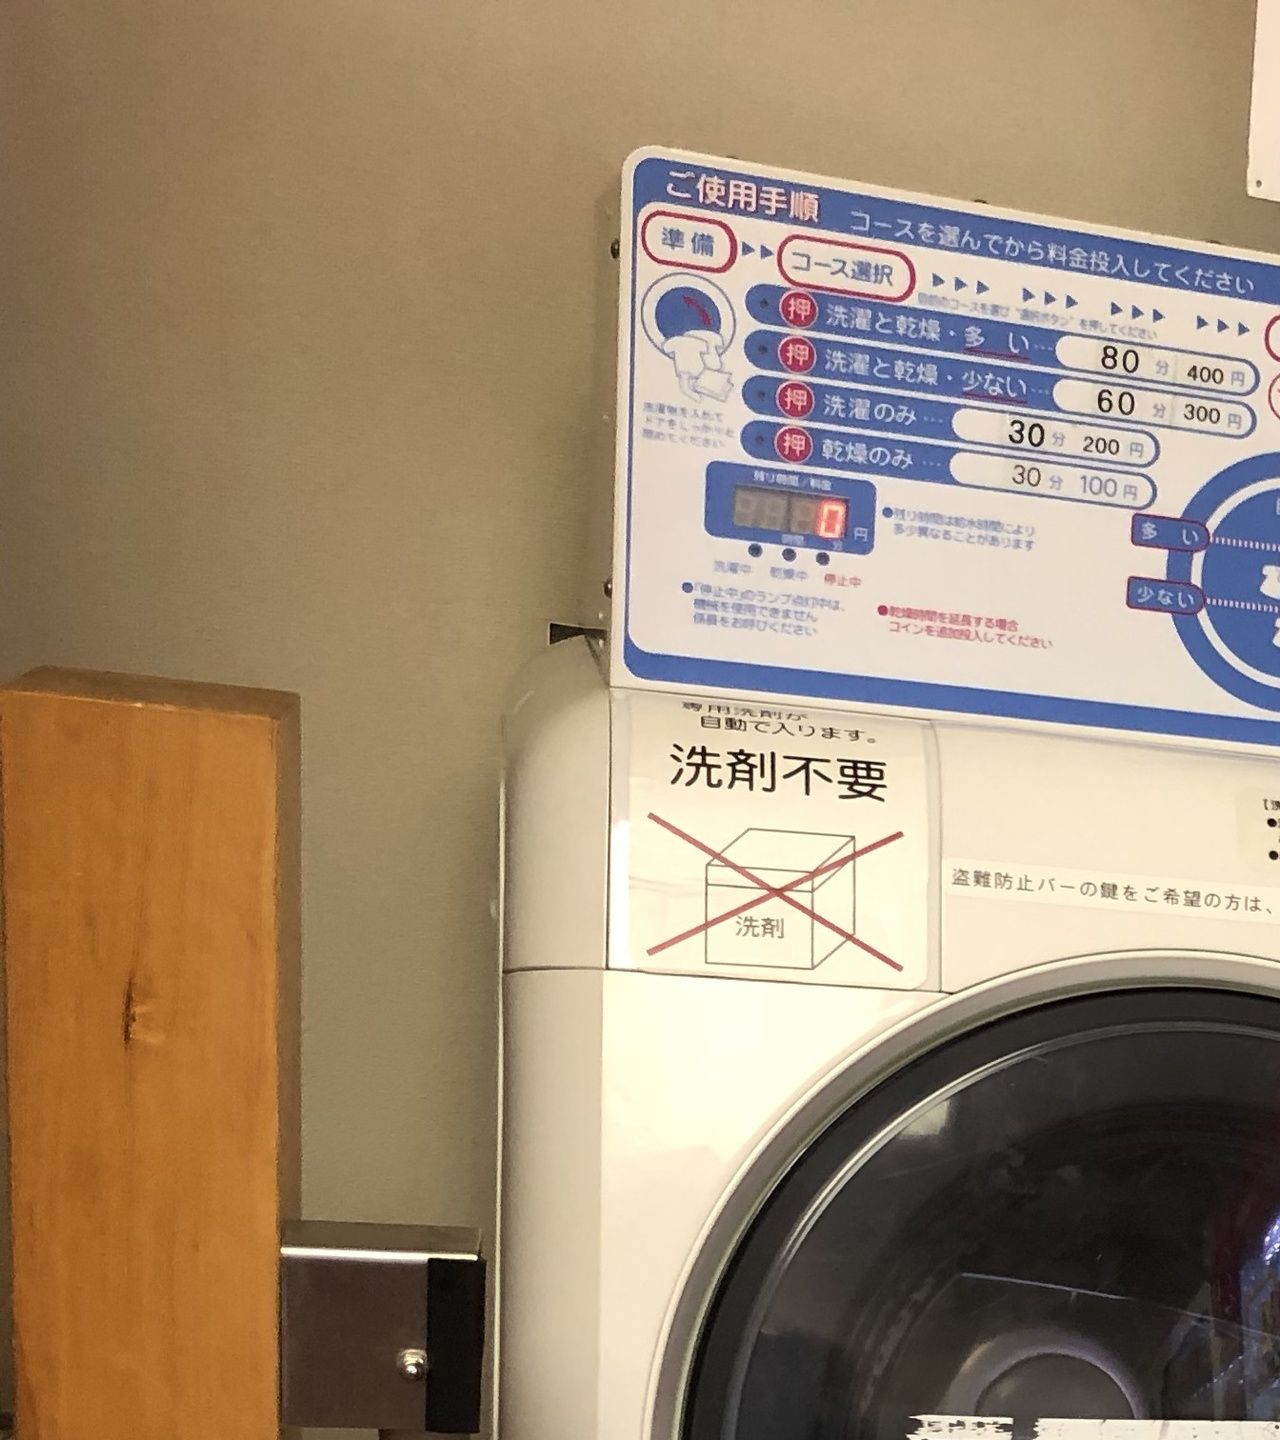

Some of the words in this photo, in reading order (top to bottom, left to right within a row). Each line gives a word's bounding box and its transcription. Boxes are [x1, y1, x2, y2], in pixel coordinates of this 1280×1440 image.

[662, 227, 715, 258] 準備
[792, 252, 893, 287] コース選択
[665, 170, 820, 224] ご使用手順
[850, 209, 1255, 294] コースを選んでから料金投入してください
[787, 297, 810, 321] 押
[1100, 345, 1140, 374] 80
[1155, 359, 1169, 376] 分
[1187, 366, 1224, 385] 400
[1231, 371, 1246, 387] 円
[786, 342, 810, 366] 押
[1097, 389, 1135, 416] 60
[1152, 403, 1166, 419] 分
[1184, 404, 1221, 424] 300
[1228, 412, 1242, 429] 円
[784, 387, 807, 411] 押
[823, 394, 917, 427] 洗濯のみ
[1008, 419, 1045, 447] 30
[1051, 431, 1066, 447] 分
[1083, 436, 1120, 456] 200
[1130, 441, 1144, 458] 円
[782, 433, 806, 457] 押
[821, 437, 914, 471] 乾燥のみ
[1012, 465, 1042, 487] 30
[1050, 475, 1064, 490] 分
[1080, 475, 1117, 497] 100
[1123, 483, 1138, 499] 円
[820, 500, 846, 540] 0
[853, 527, 868, 542] 円
[824, 573, 862, 588] 停止中
[1137, 585, 1196, 610] 少ない
[700, 716, 877, 743] 自動で入ります。
[669, 743, 888, 802] 洗剤不要
[735, 915, 785, 939] 洗剤
